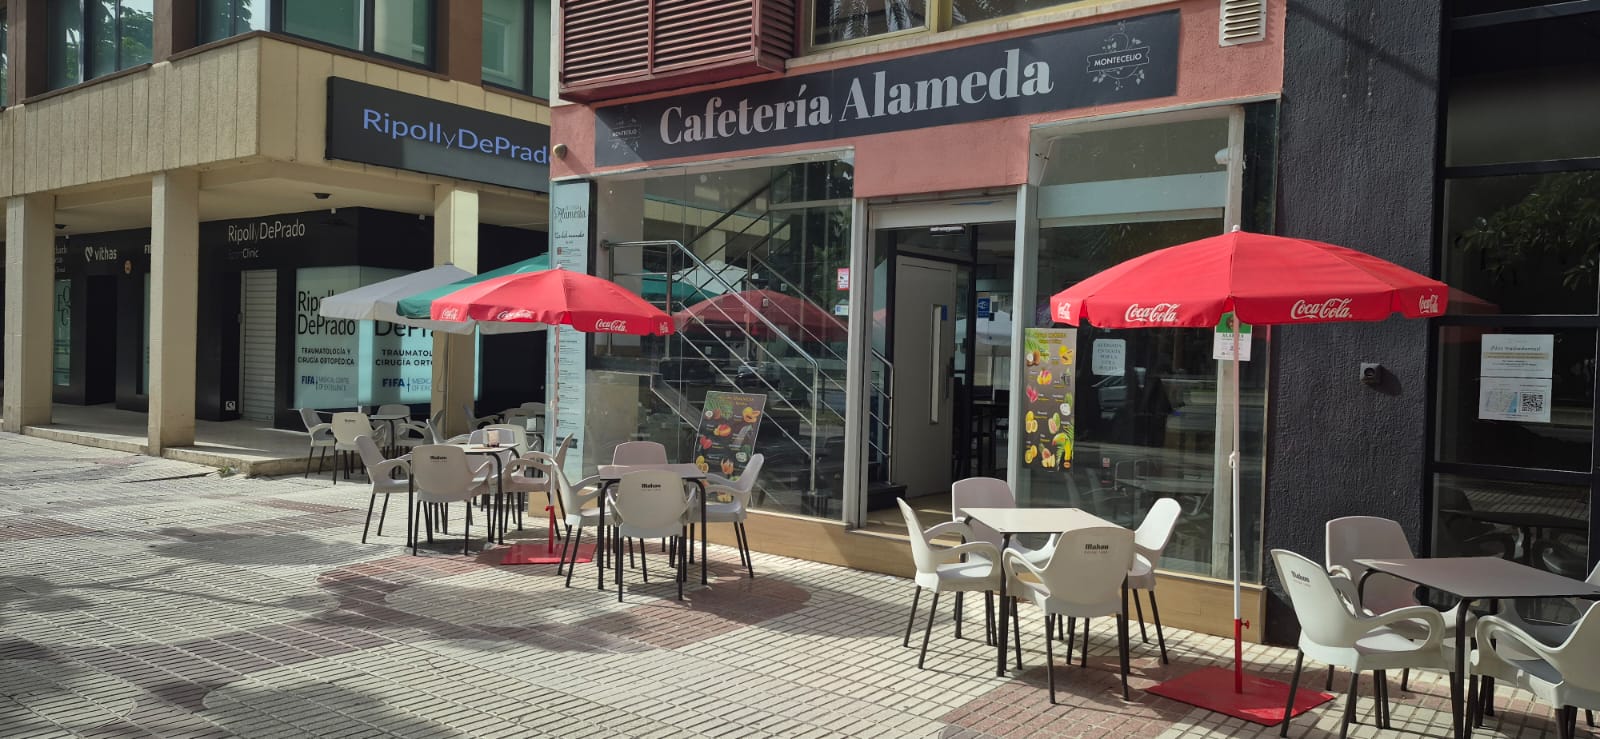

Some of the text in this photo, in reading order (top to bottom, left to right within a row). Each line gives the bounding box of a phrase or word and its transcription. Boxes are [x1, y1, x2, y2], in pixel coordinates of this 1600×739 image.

[1093, 53, 1142, 67] MONTECELIO
[659, 47, 1055, 145] Cafetería Alameda
[362, 108, 551, 165] RipollyDePrad
[228, 218, 306, 245] RipollyDePrado
[95, 247, 117, 261] vithas
[1124, 303, 1181, 322] Coca-Cola
[1290, 297, 1353, 320] Coca-Cola
[297, 314, 356, 336] DePrado
[595, 318, 627, 332] Coca-Cola
[413, 359, 433, 367] ORT
[301, 375, 315, 385] FIFA
[382, 378, 405, 388] FIFA
